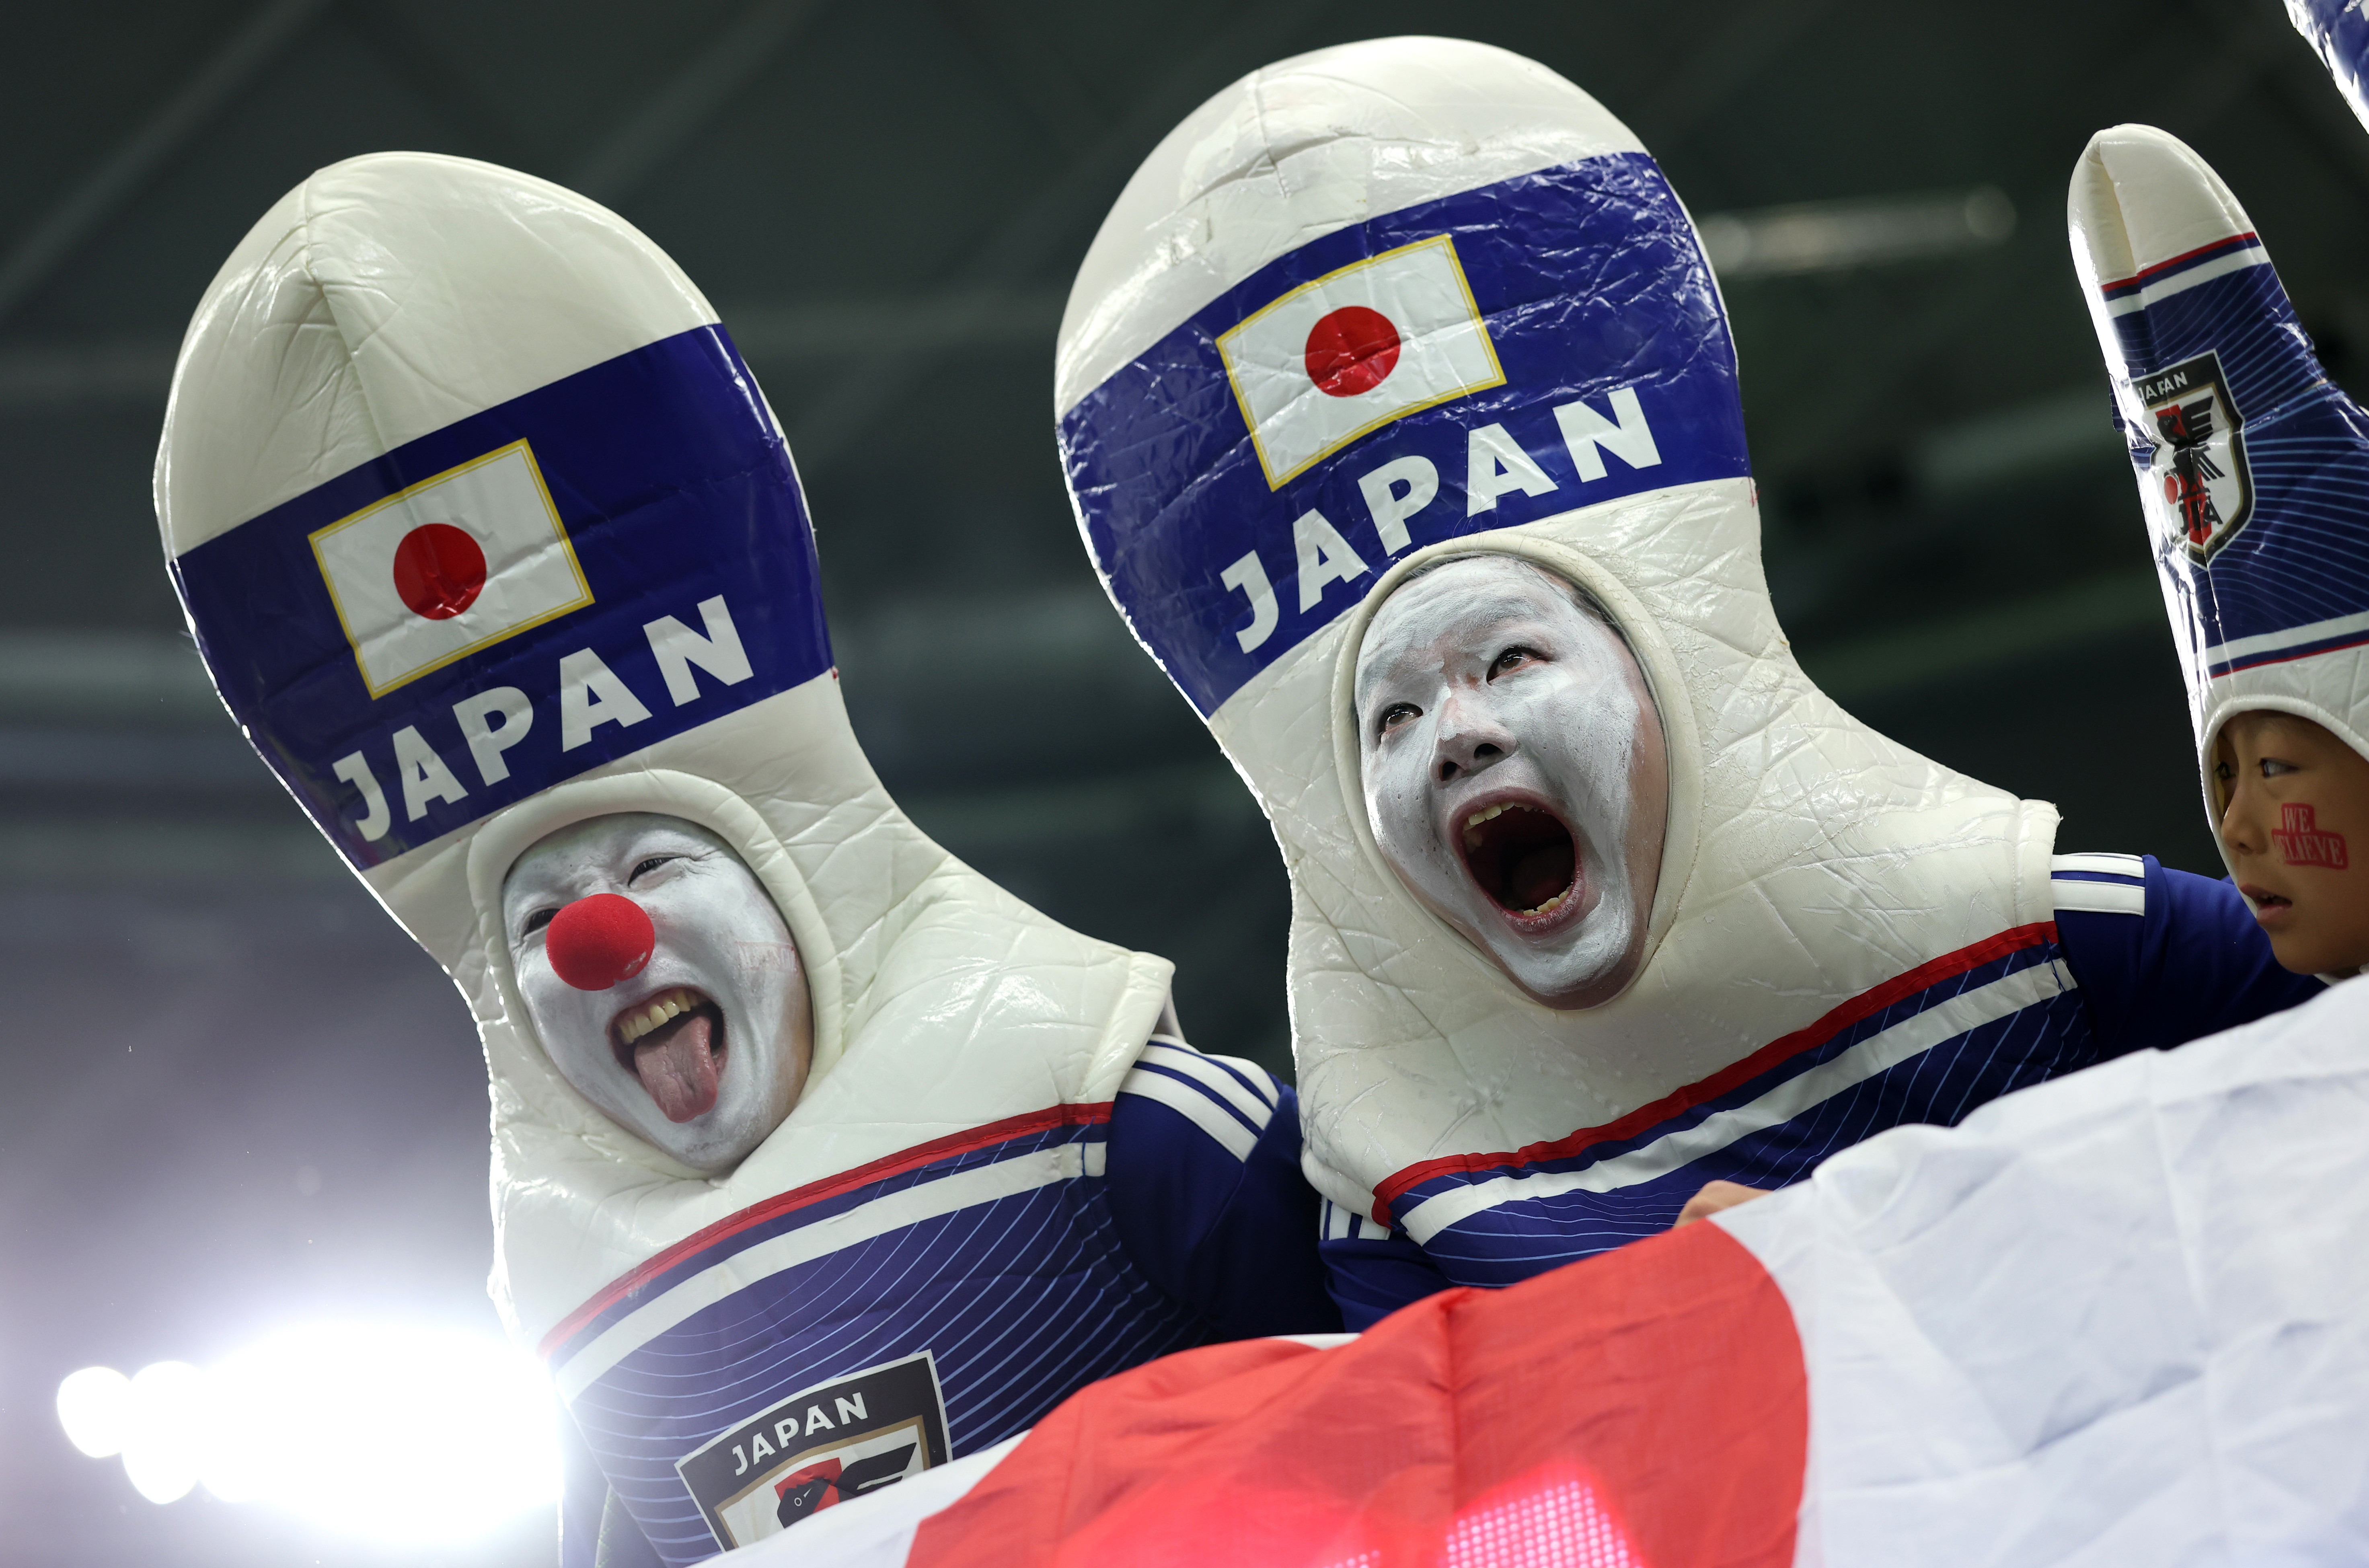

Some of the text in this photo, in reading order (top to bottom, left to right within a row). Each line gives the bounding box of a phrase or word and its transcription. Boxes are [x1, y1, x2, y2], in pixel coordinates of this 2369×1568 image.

[2138, 371, 2188, 401] JAPAN
[1219, 386, 1662, 654] JAPAN
[331, 594, 754, 843] JAPAN
[2285, 808, 2310, 832] WE
[732, 1392, 868, 1476] JAPAN
